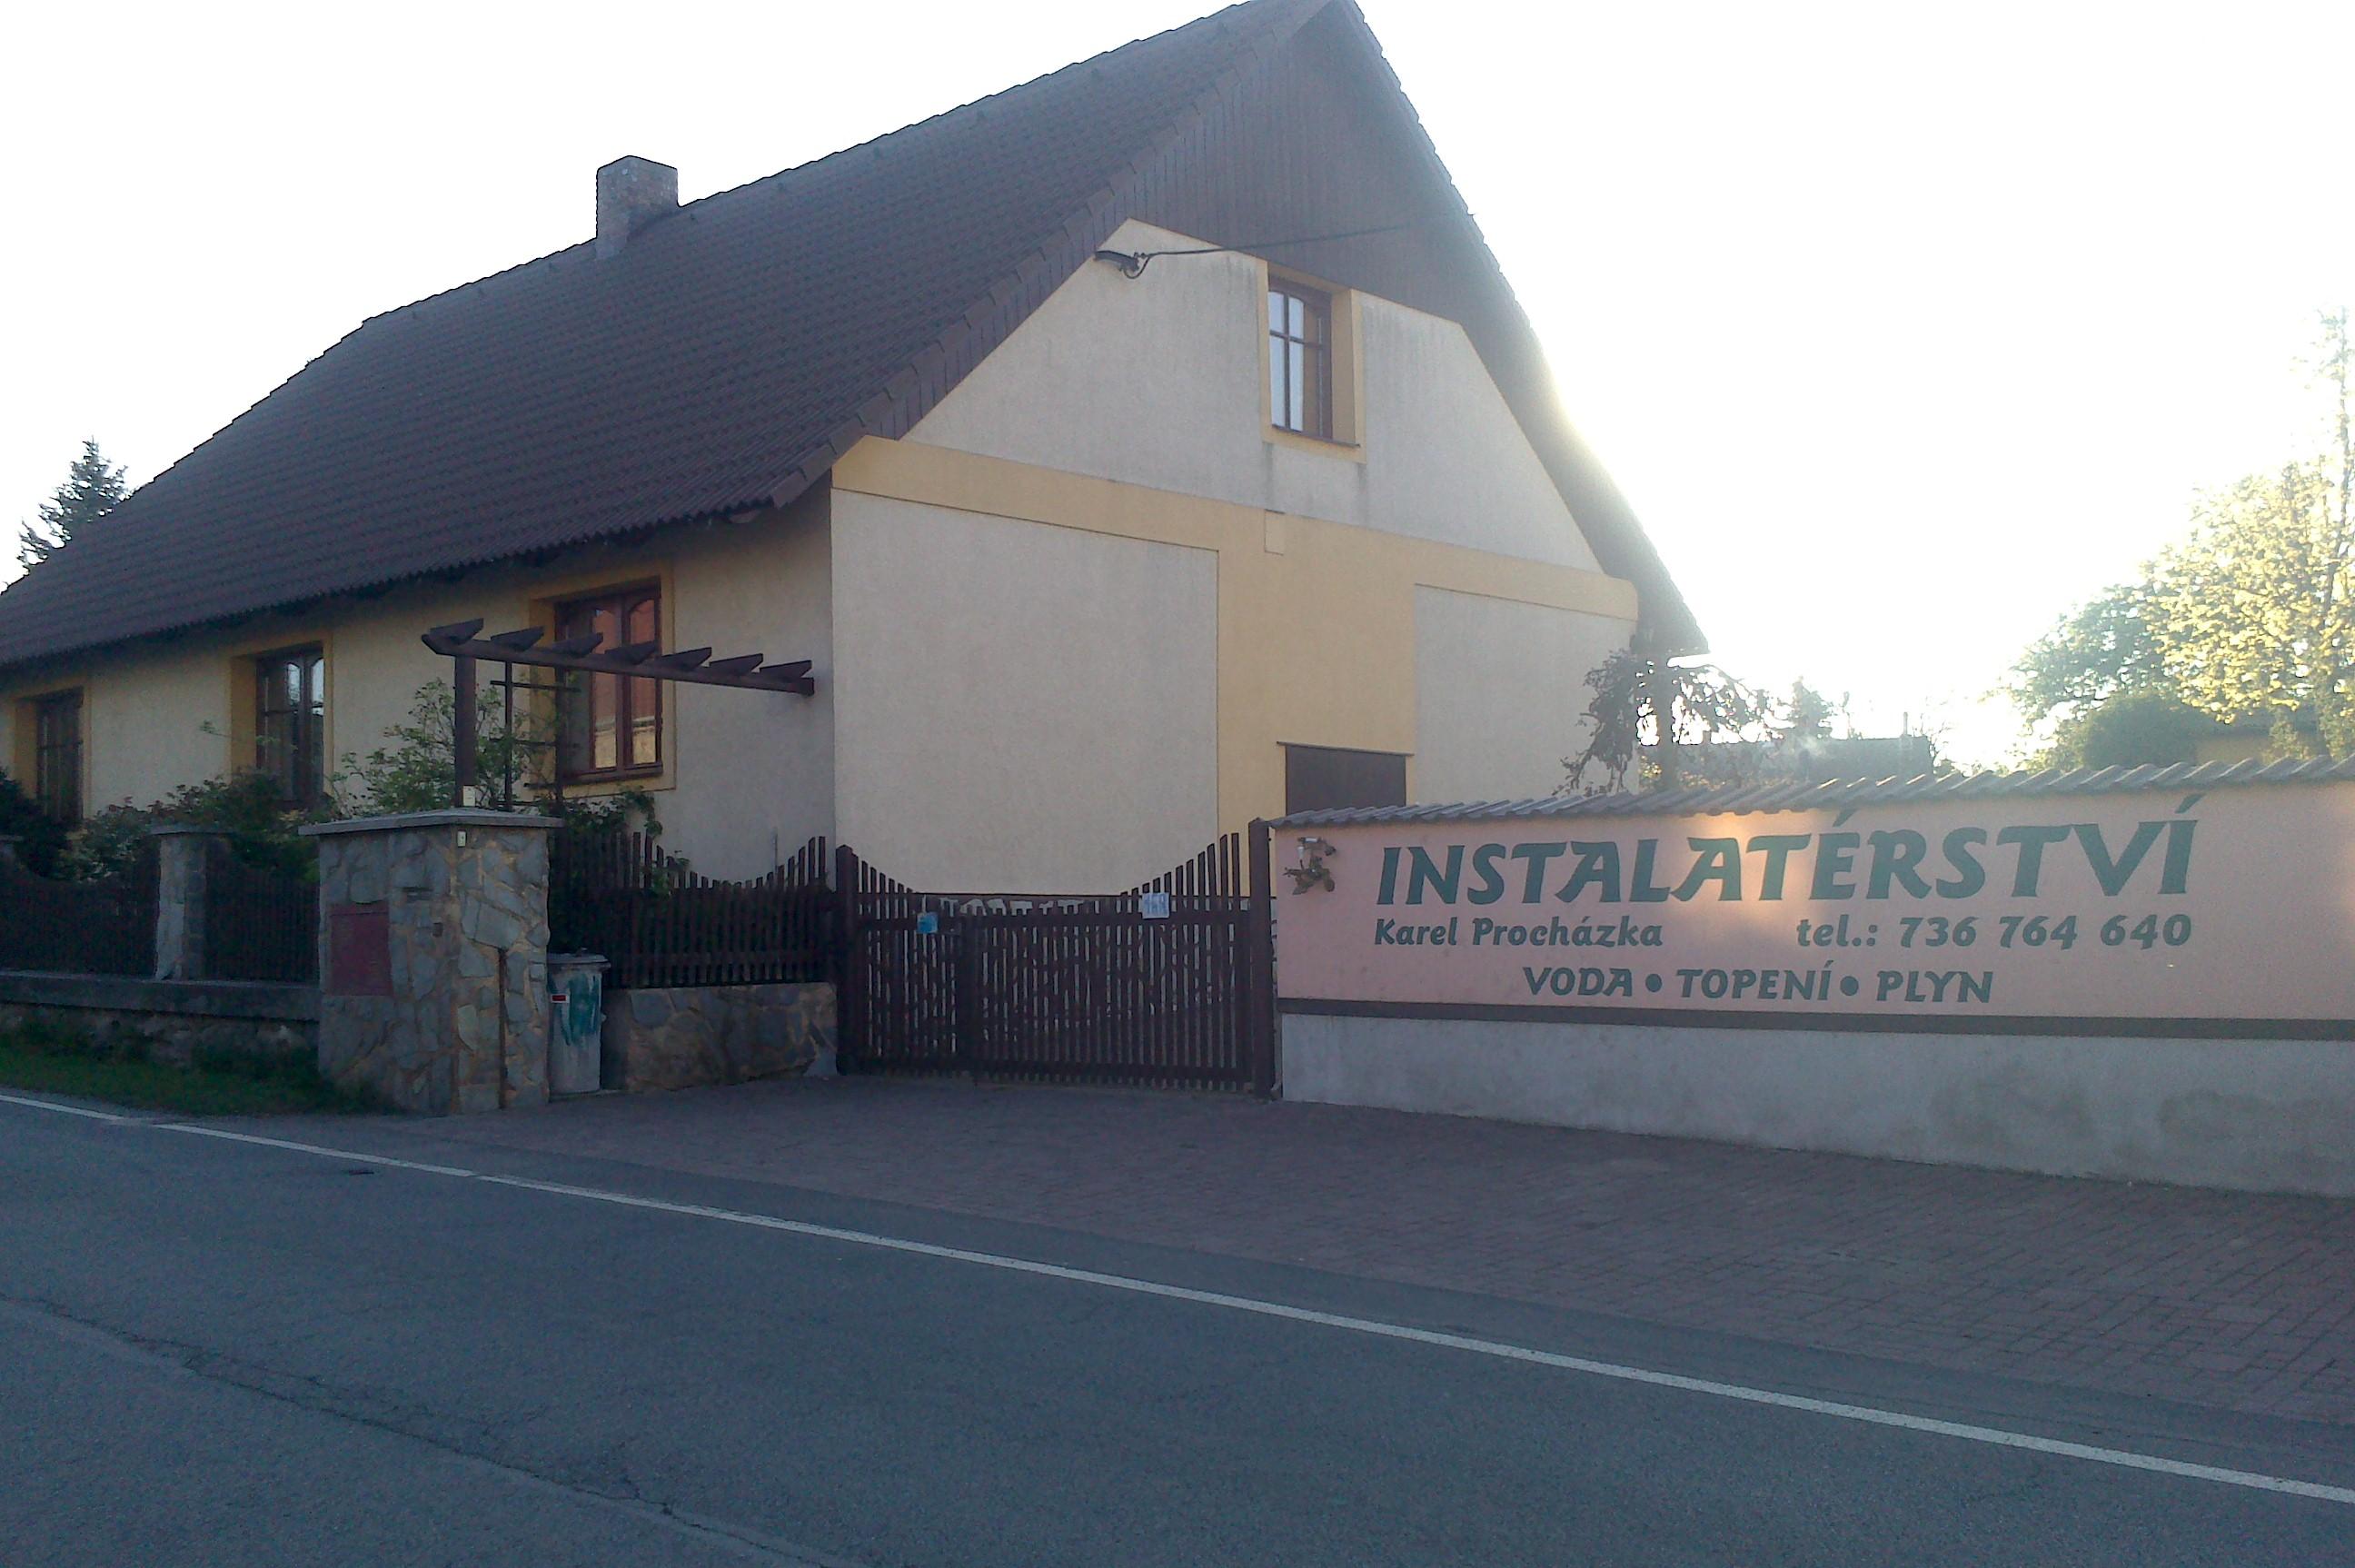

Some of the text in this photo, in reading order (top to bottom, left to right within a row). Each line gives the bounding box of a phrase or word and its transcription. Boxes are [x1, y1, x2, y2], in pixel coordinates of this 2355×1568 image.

[1376, 794, 2205, 904] INSTALATÉRSTVÍ
[1375, 916, 1664, 947] Karel Procházka
[1796, 914, 2191, 950] tel.: 736 764 640
[1523, 960, 1993, 1003] VODA TOPENÍ PLYN
